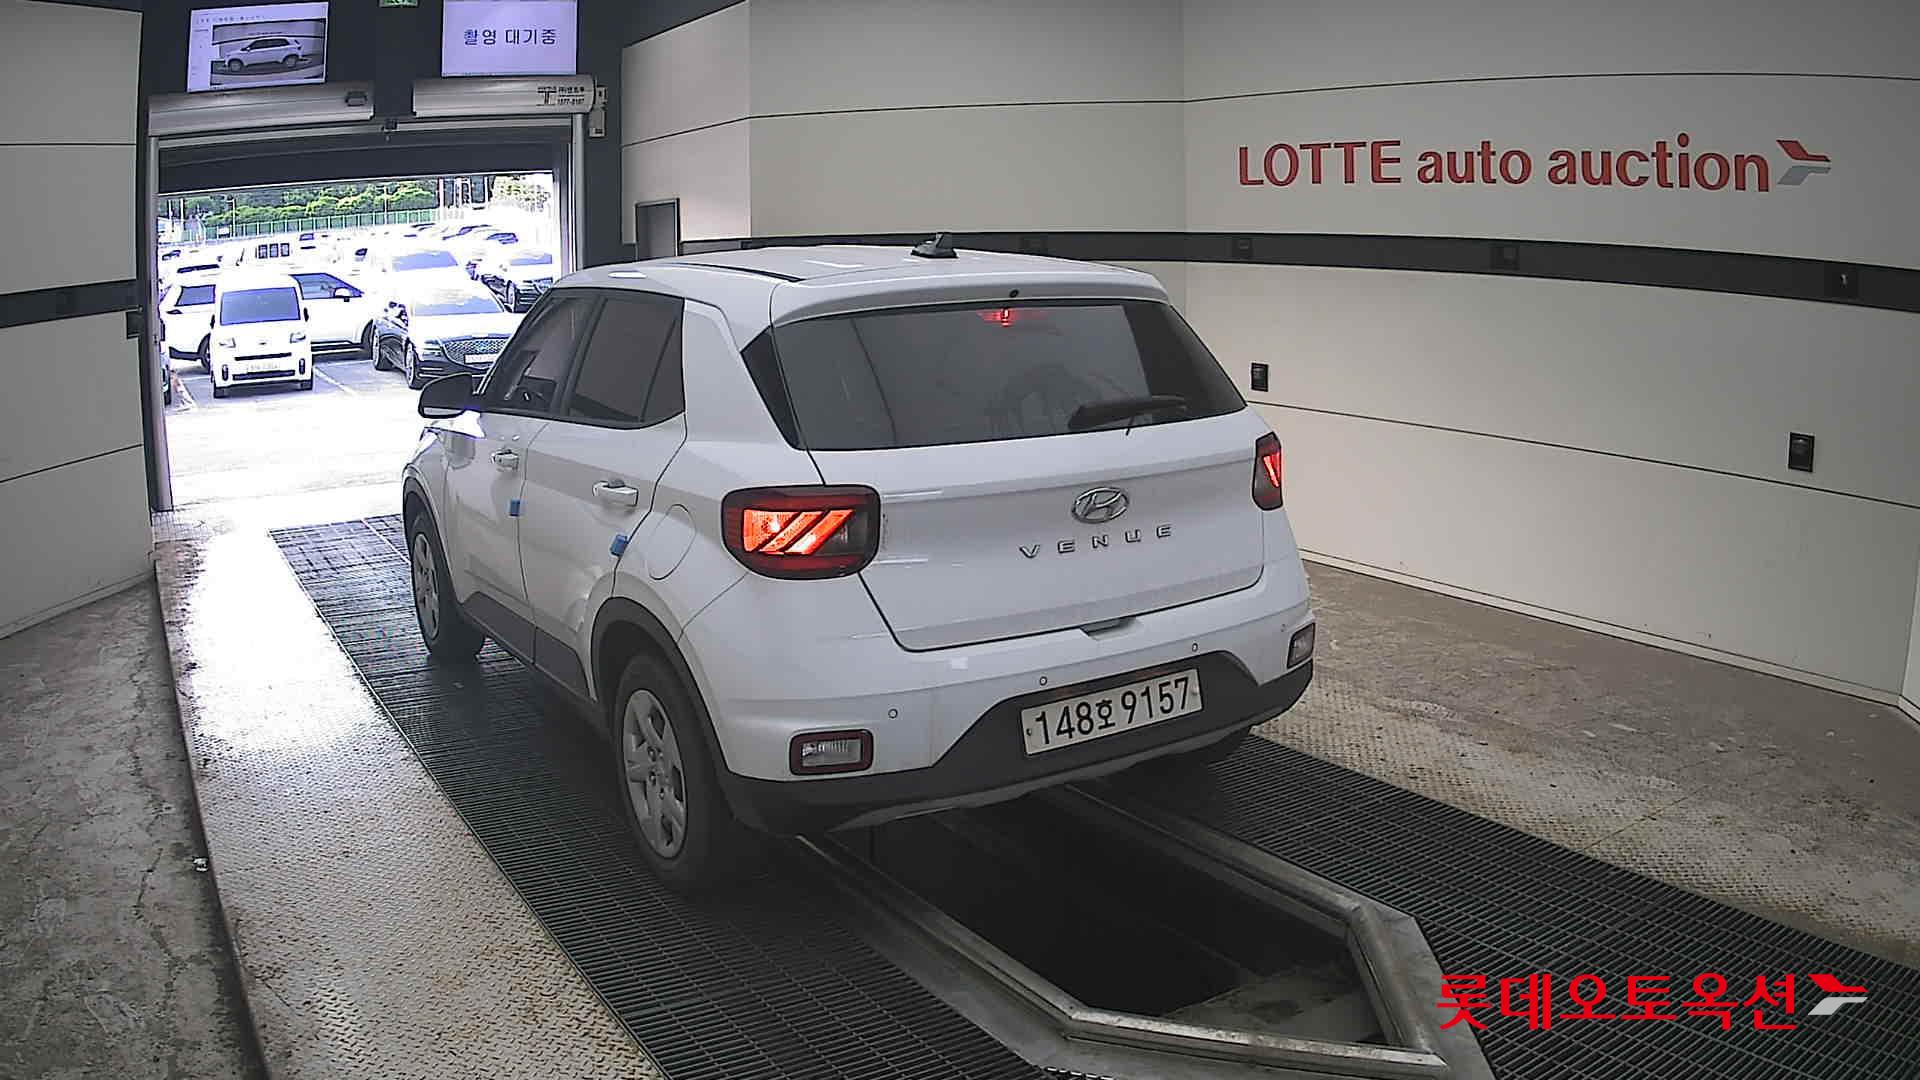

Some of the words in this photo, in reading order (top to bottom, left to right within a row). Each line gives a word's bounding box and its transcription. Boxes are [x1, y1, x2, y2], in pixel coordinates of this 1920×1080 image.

[464, 29, 497, 46] 촬영
[505, 29, 557, 45] 대기중
[1239, 140, 1401, 186] LOTTE
[1417, 140, 1532, 185] auto
[1548, 132, 1769, 192] auction
[1019, 524, 1171, 559] VENUE
